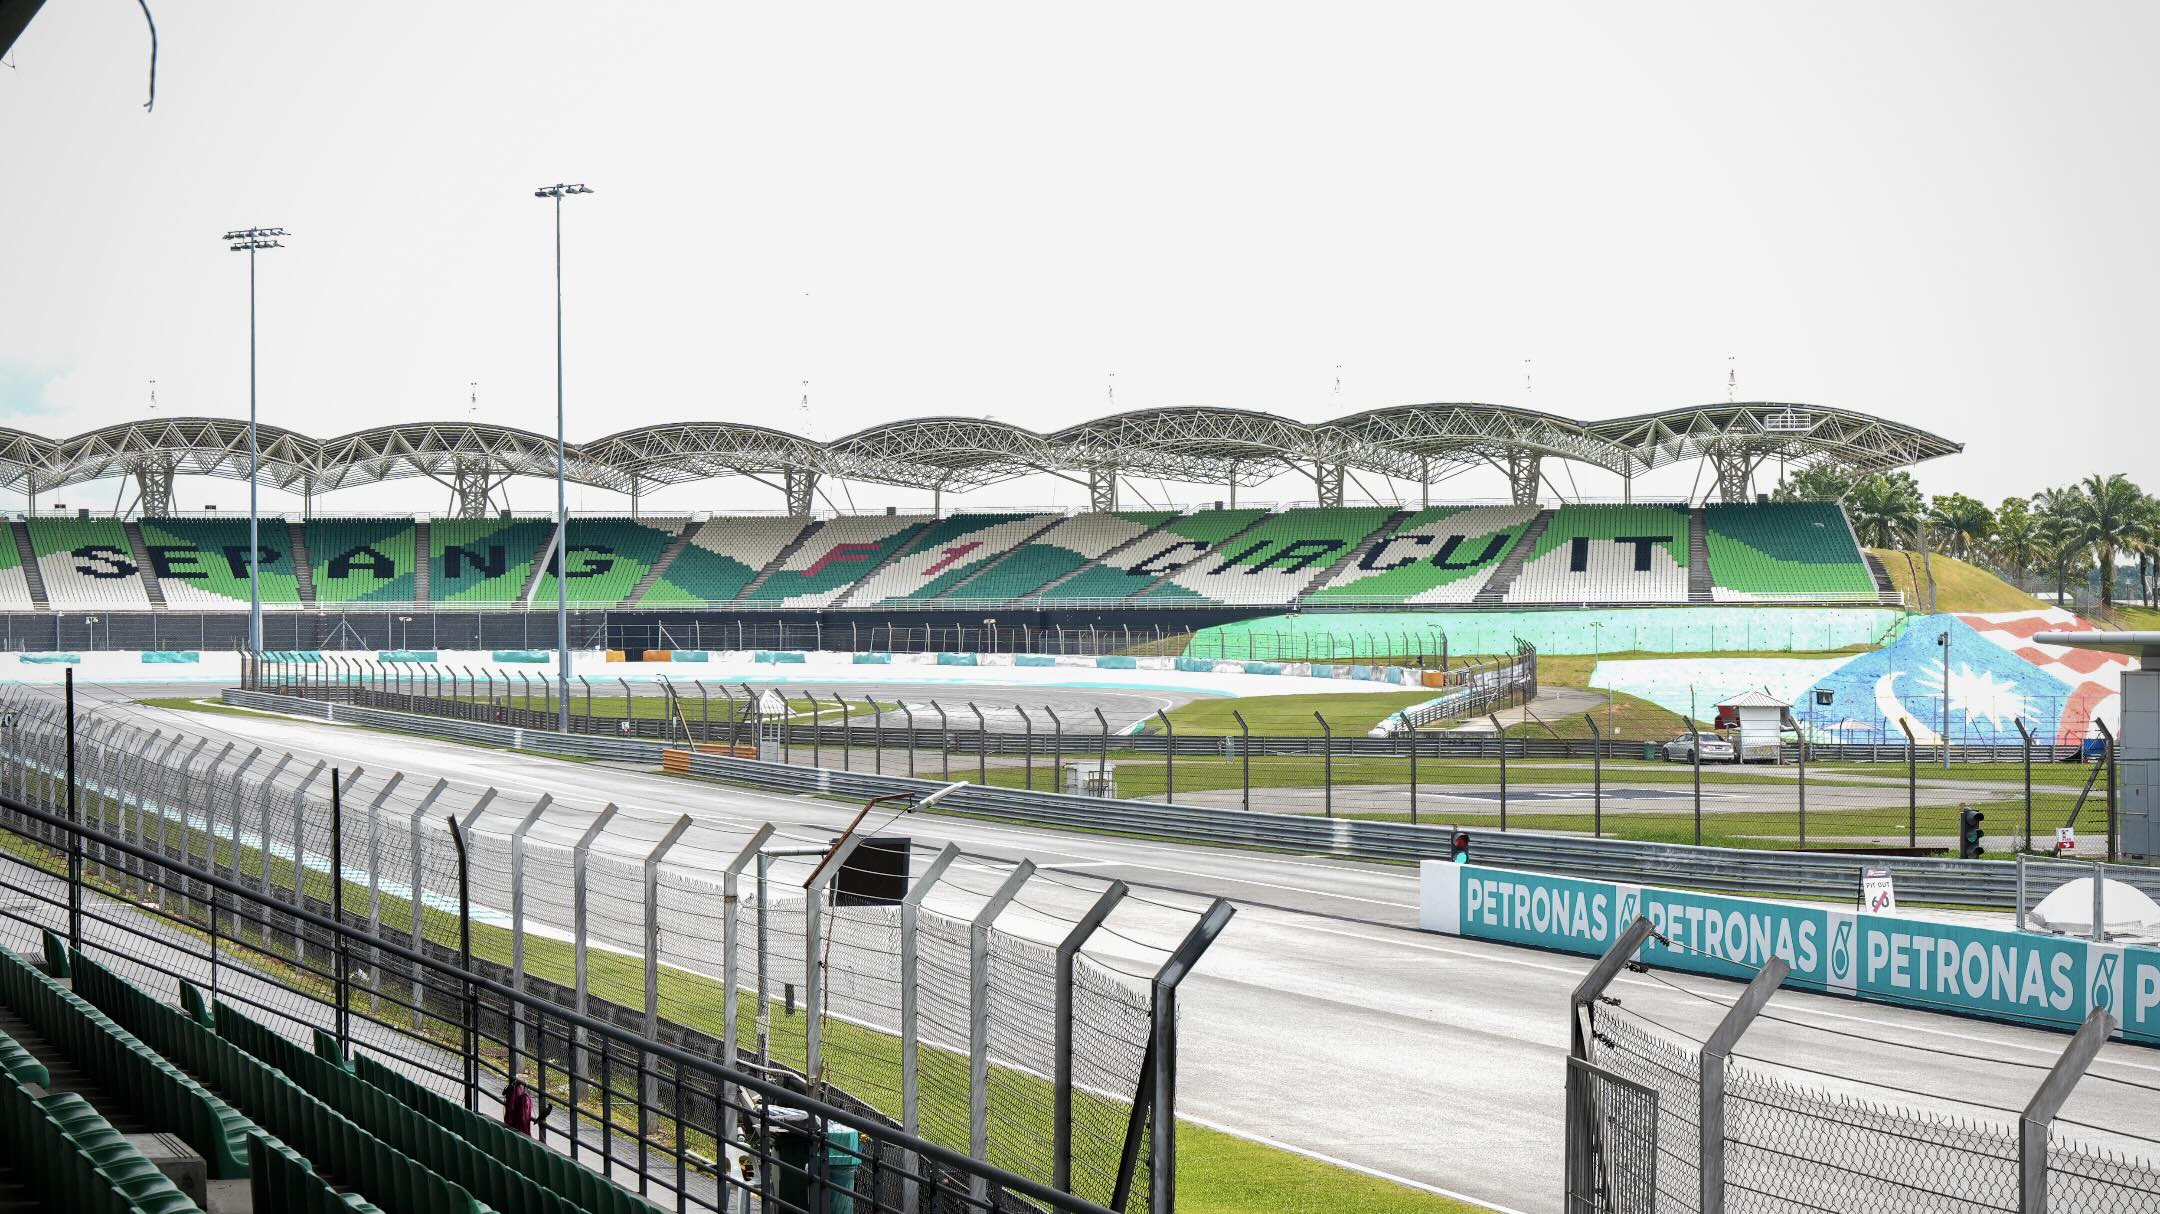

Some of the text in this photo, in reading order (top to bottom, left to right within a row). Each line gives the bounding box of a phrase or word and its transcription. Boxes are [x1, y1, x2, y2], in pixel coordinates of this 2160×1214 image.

[71, 535, 1673, 580] SEPANG F1 CIRCUIT
[1467, 878, 1609, 942] PETRONAS
[1649, 901, 1819, 973] PETRONAS
[1867, 930, 2074, 1011] PETRONAS
